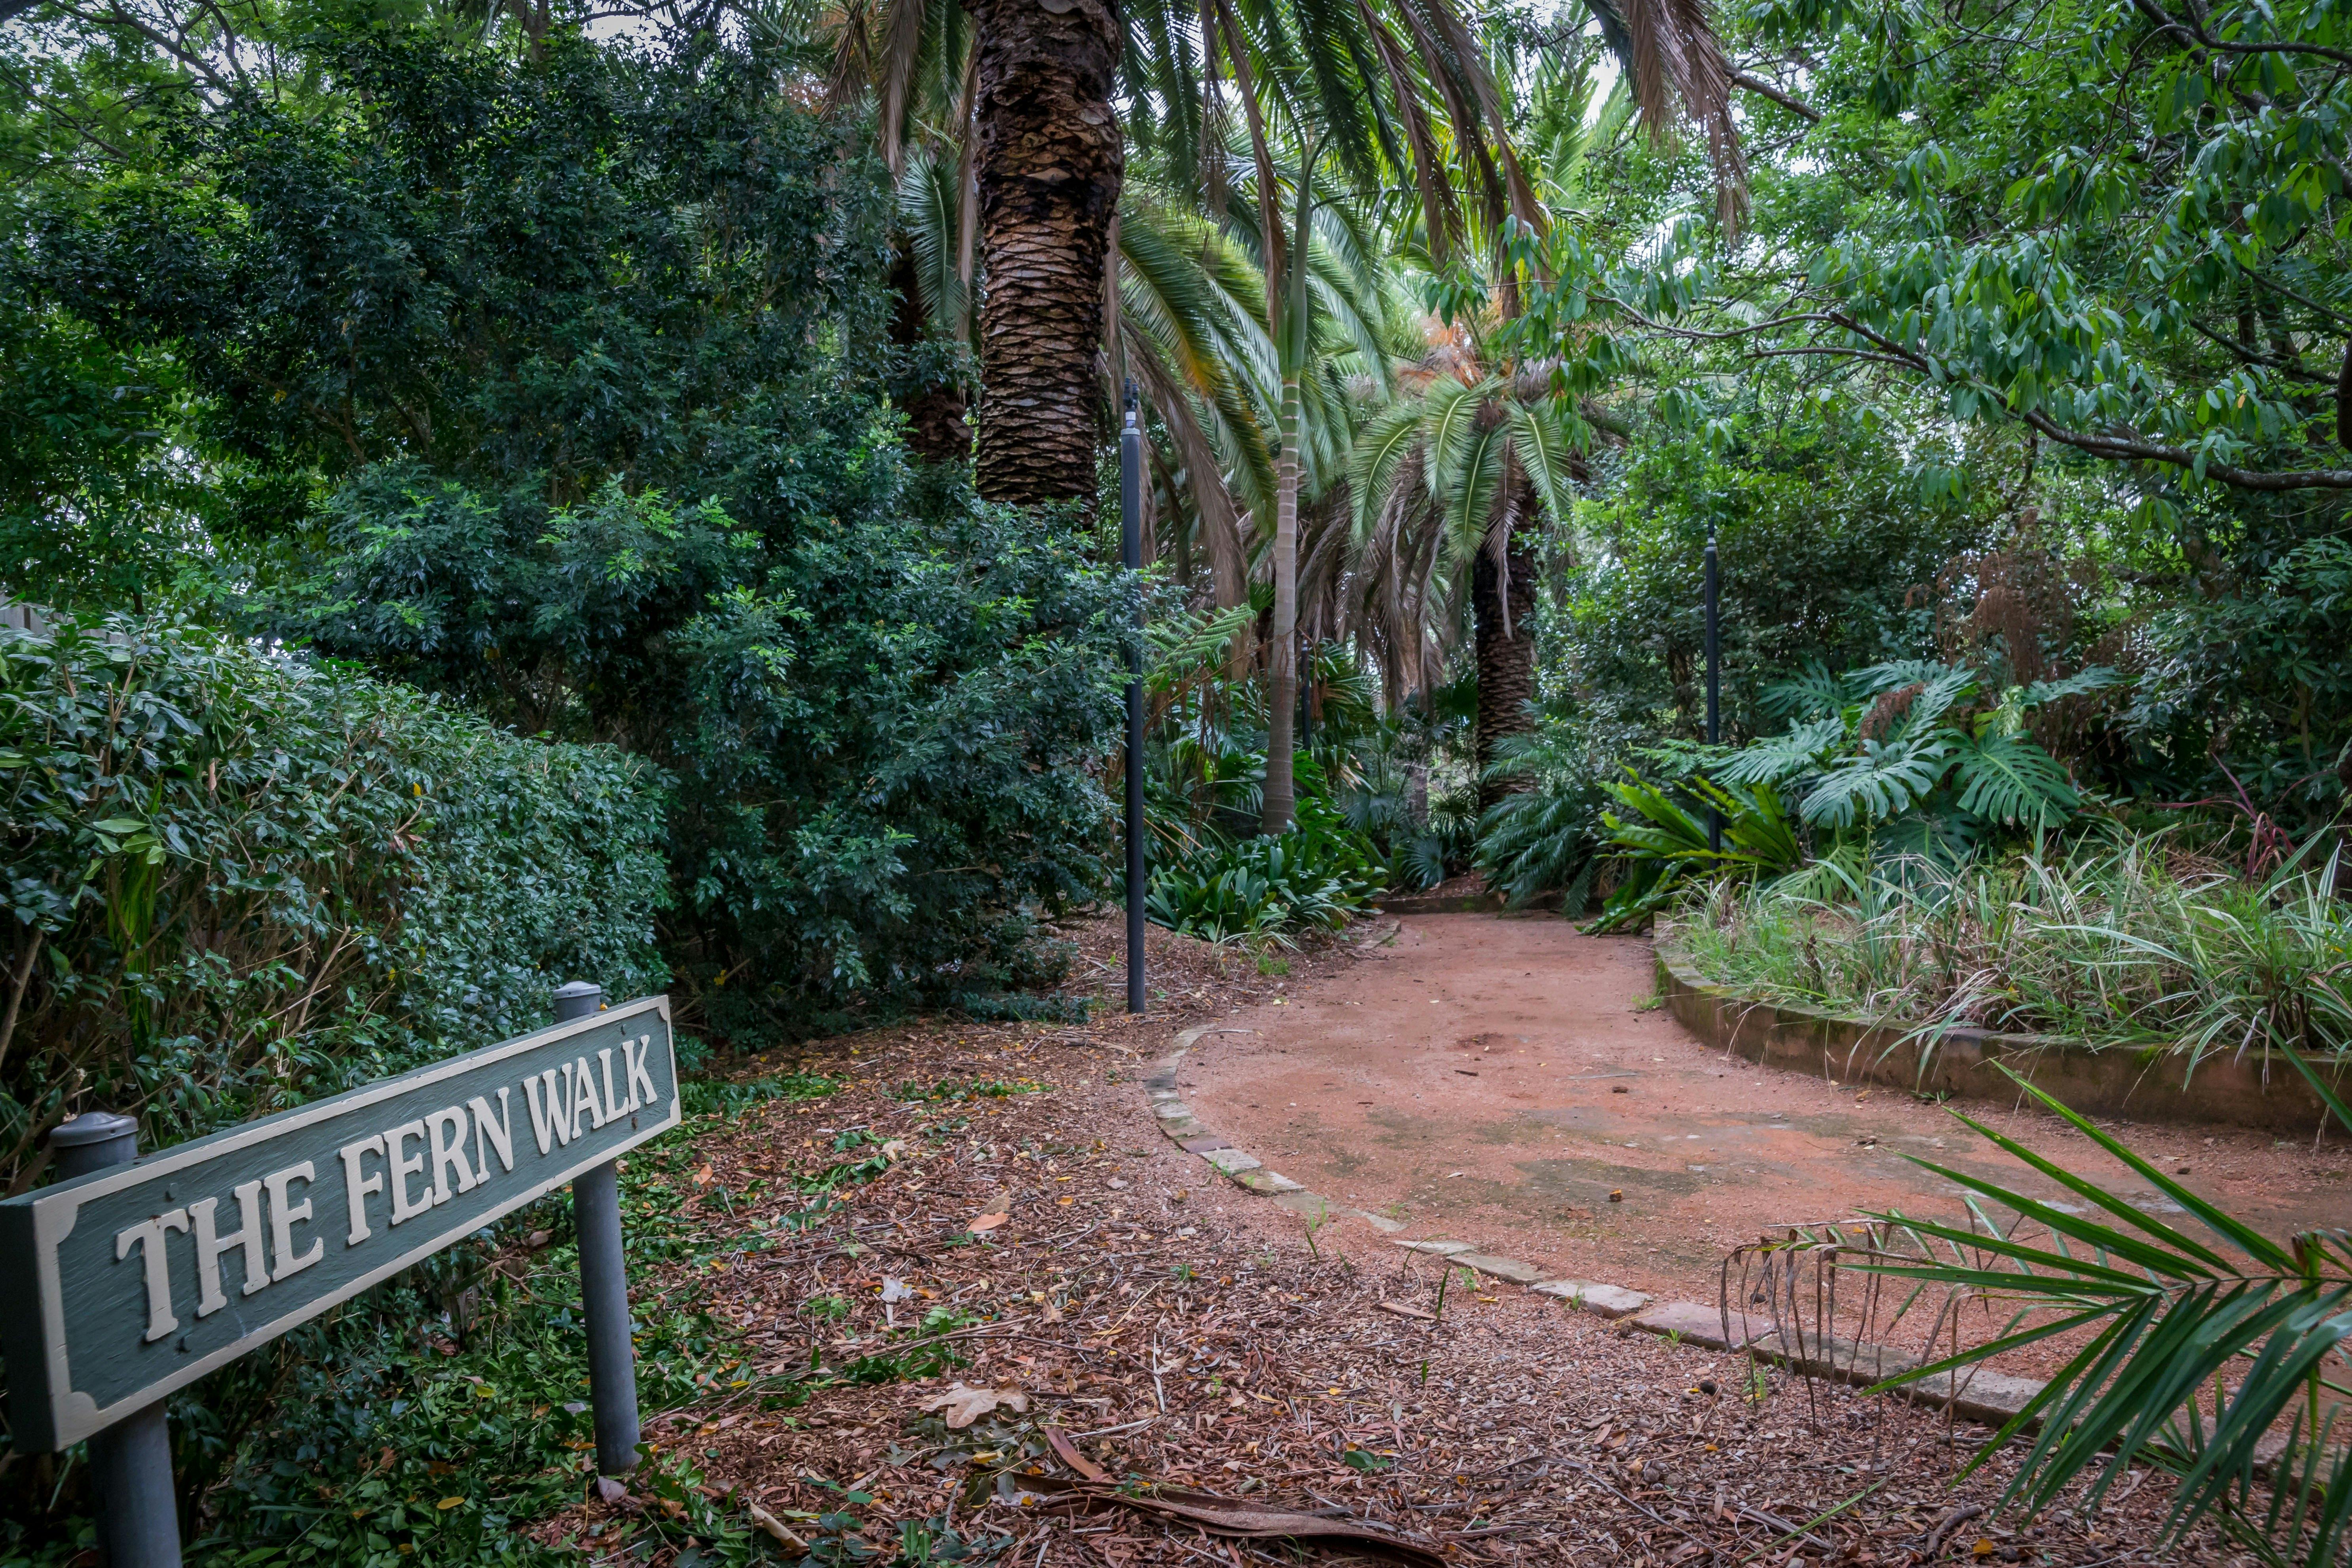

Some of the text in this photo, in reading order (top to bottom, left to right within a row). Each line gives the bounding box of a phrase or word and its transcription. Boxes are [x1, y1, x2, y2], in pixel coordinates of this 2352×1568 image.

[116, 1035, 658, 1342] THE FERN WALK
